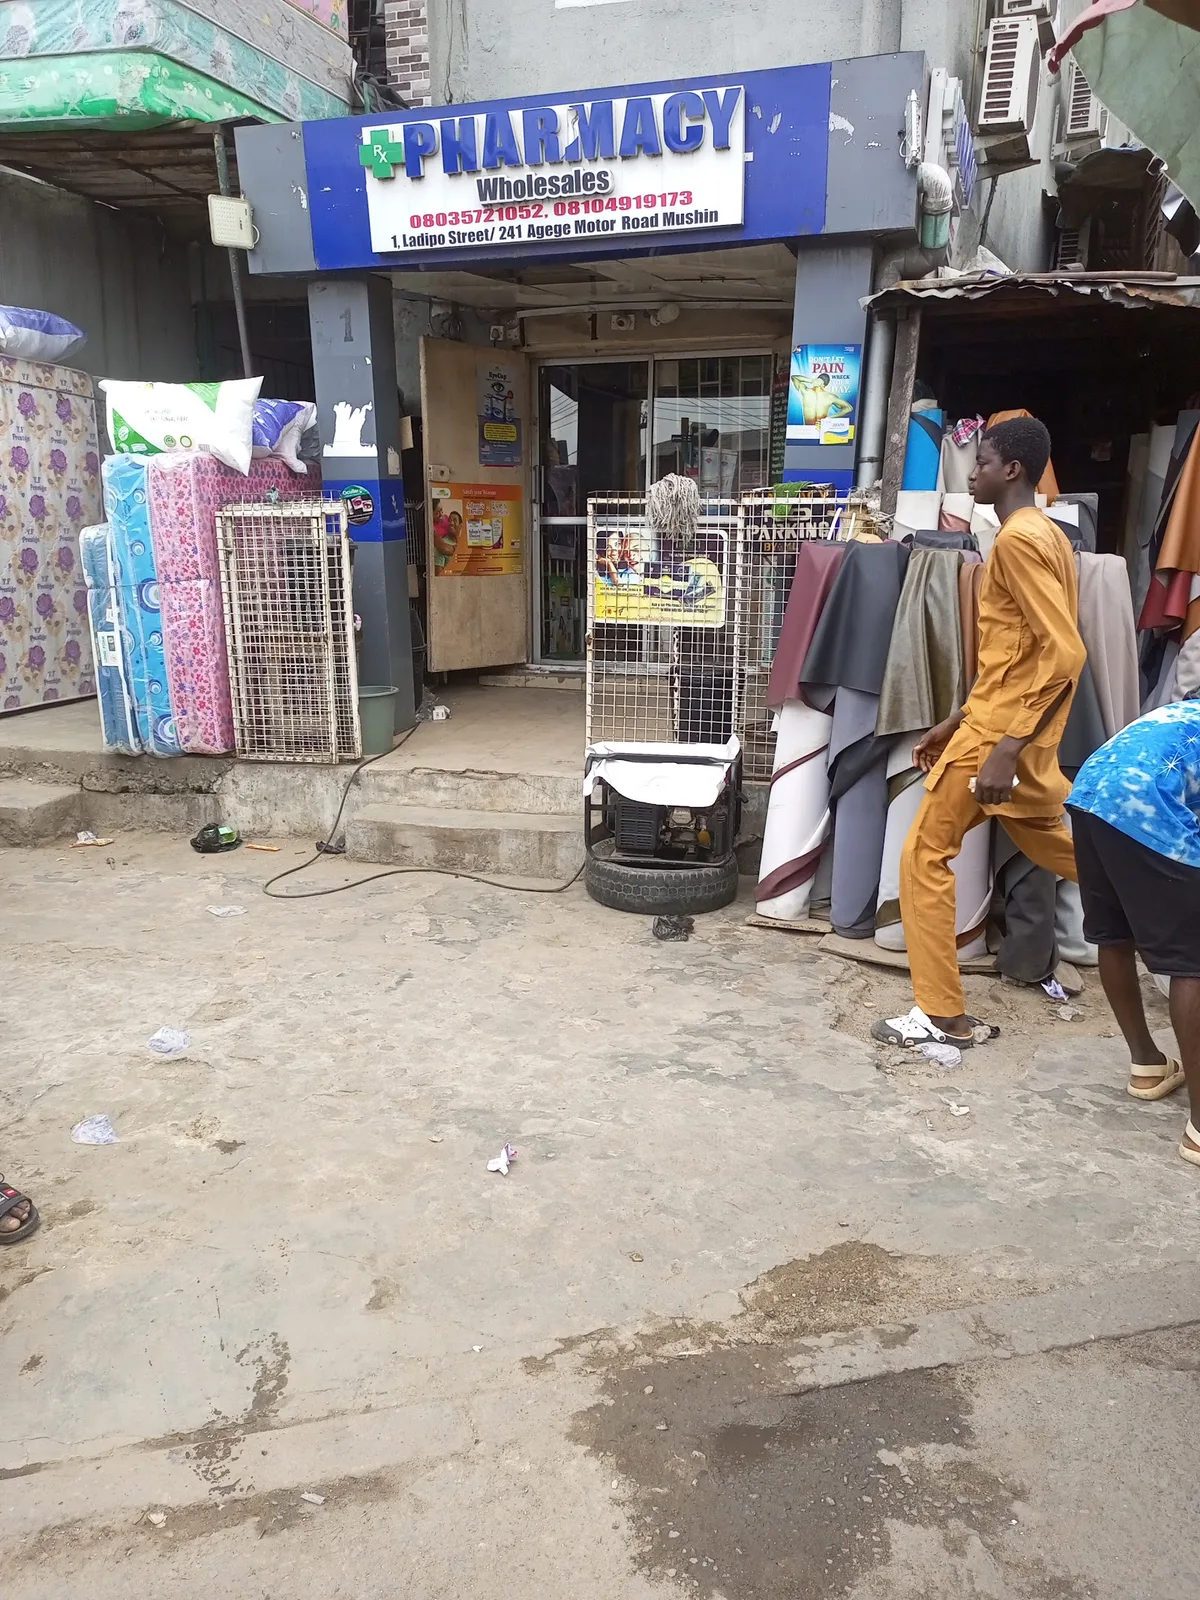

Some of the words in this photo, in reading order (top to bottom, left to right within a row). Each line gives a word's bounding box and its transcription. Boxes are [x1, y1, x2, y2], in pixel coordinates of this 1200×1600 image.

[403, 87, 742, 179] PHARMACY
[476, 168, 610, 202] Wholesales
[409, 203, 549, 229] 08035721052,
[553, 190, 693, 217] 08104919173
[391, 235, 400, 249] 1,
[402, 233, 446, 248] Ladipo
[448, 226, 496, 245] Street/
[499, 224, 522, 240] 241
[527, 223, 571, 239] Agege
[574, 217, 616, 233] Motor
[621, 213, 659, 230] Road
[662, 208, 719, 227] Mushin
[812, 362, 845, 374] PAIN
[746, 520, 832, 541] PARKING
